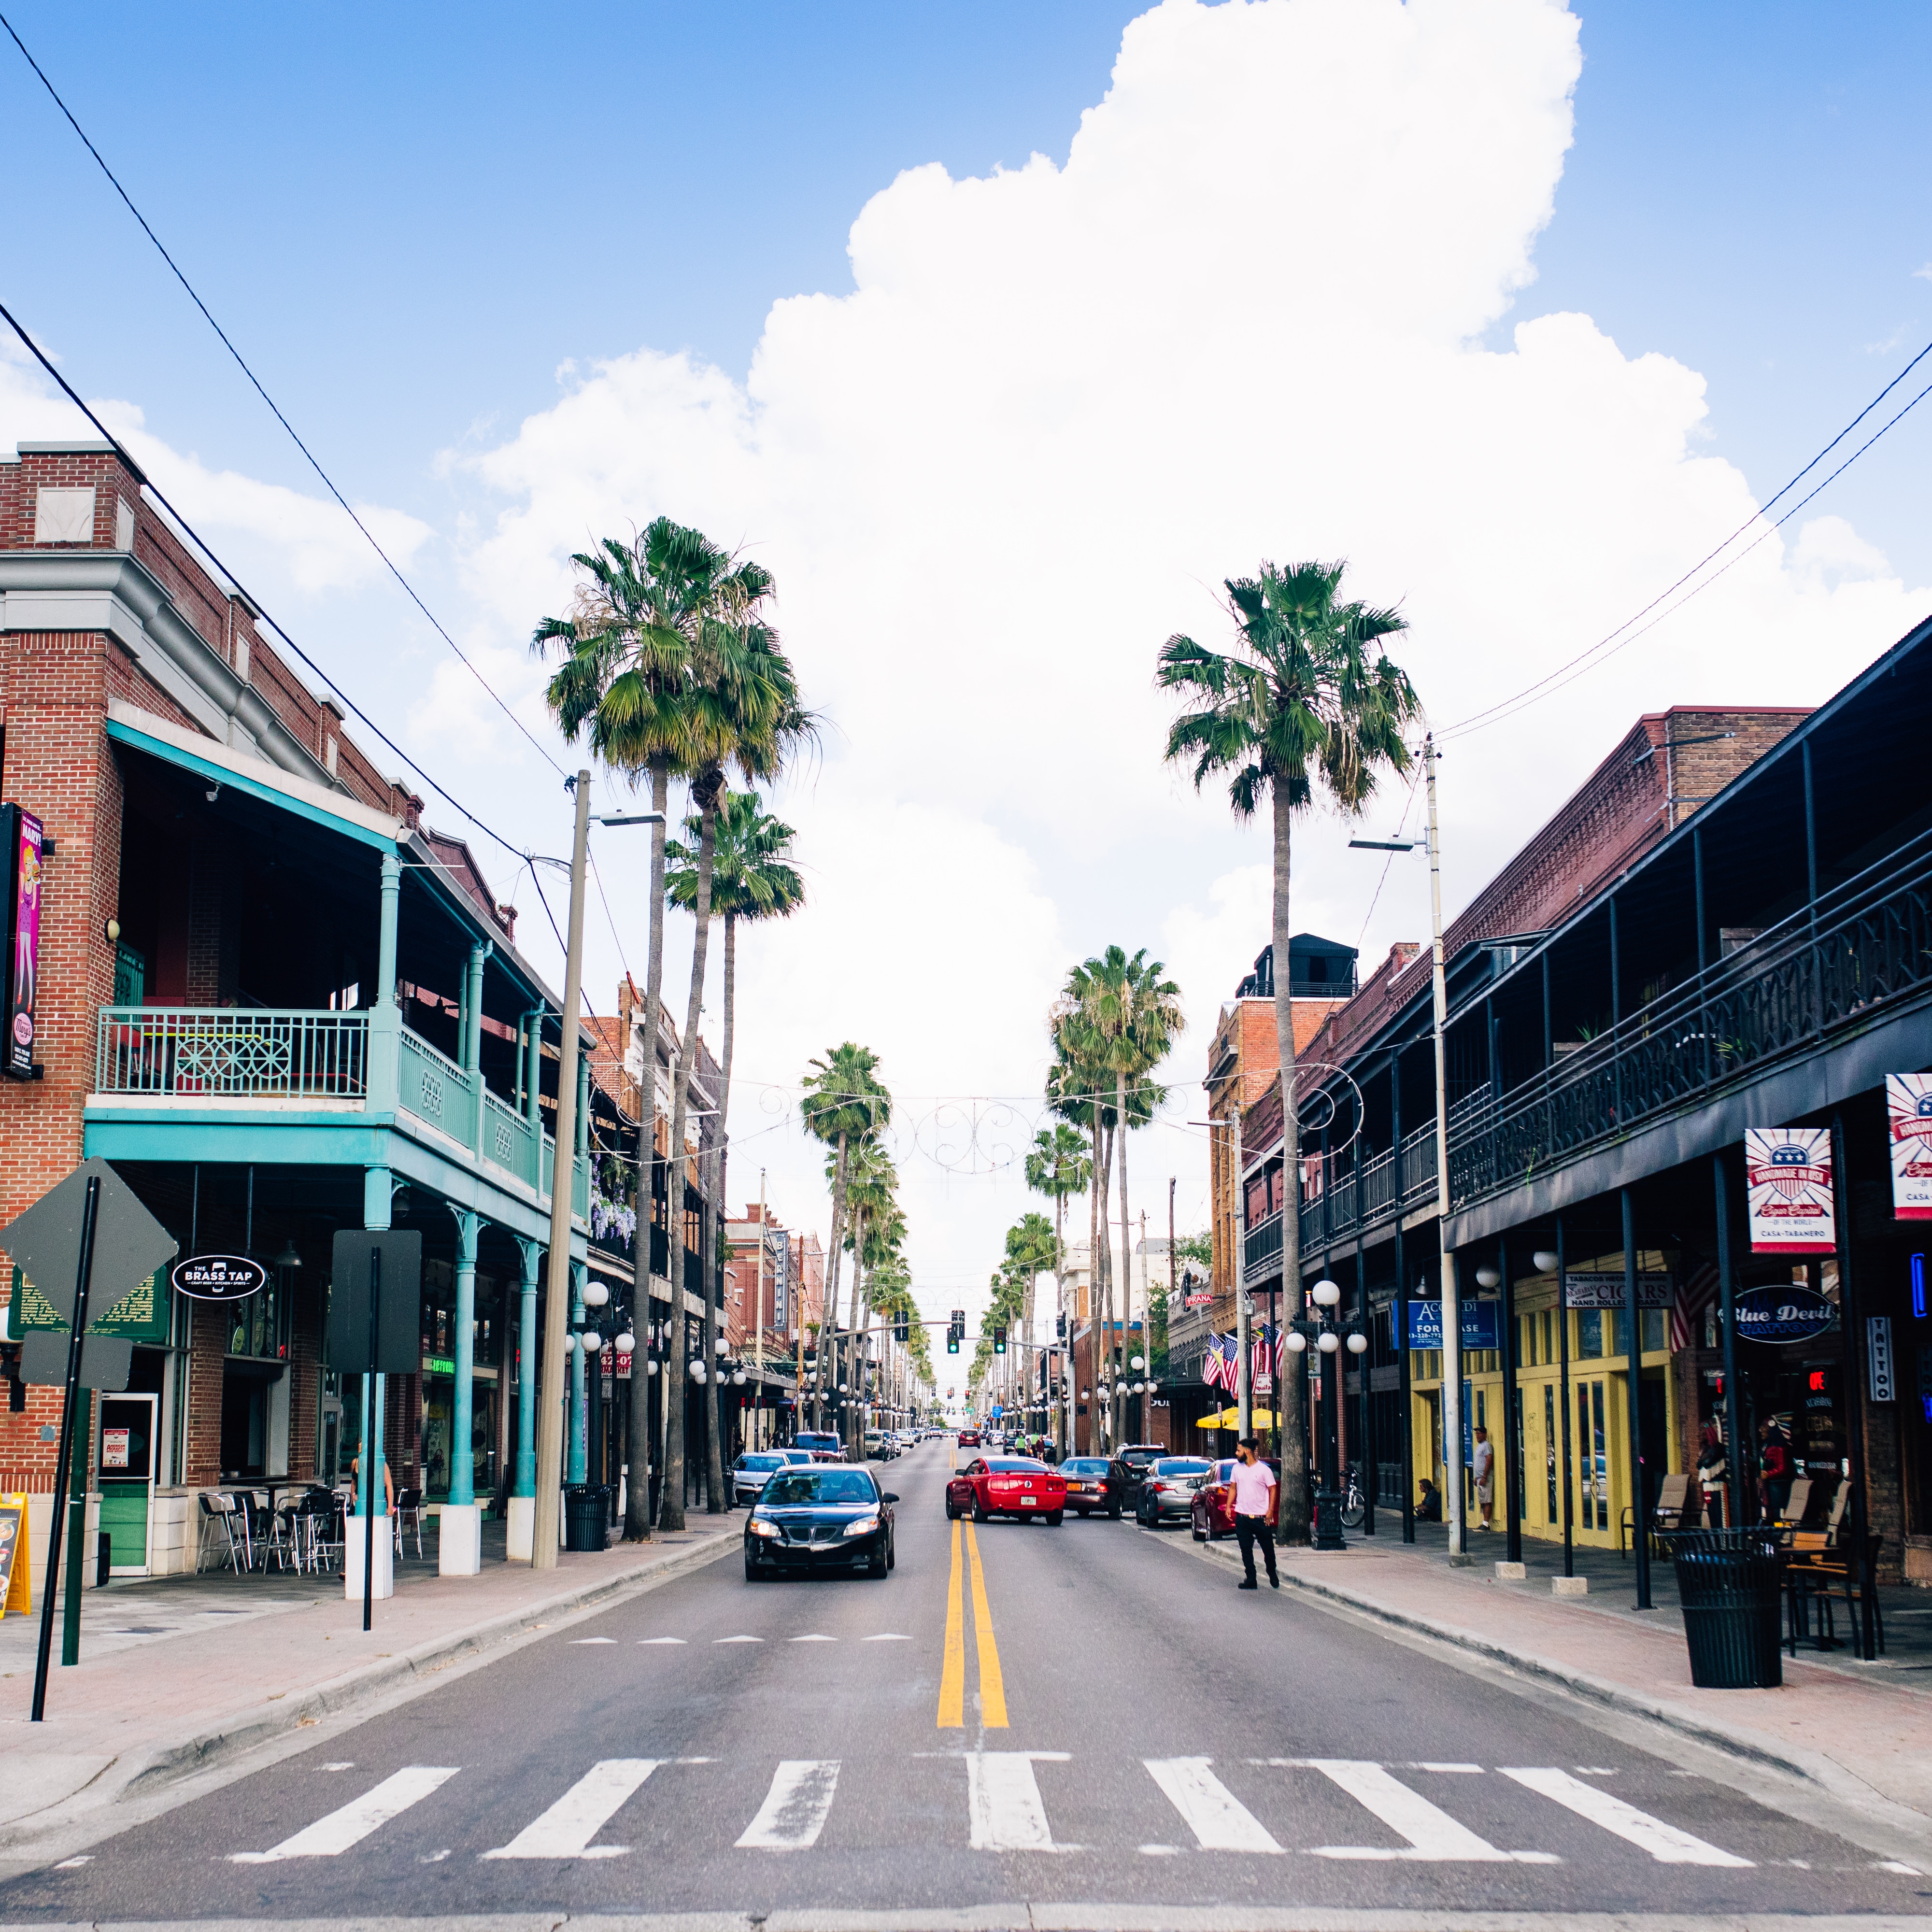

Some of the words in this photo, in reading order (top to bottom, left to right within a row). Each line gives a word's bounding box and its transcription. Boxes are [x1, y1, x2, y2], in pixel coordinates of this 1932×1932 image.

[22, 823, 42, 847] MARY!
[16, 1017, 32, 1038] Mary's
[1899, 1120, 1932, 1136] HANDM
[1754, 1169, 1797, 1182] HANDMADE
[1798, 1169, 1807, 1179] IN
[1808, 1170, 1824, 1183] USA
[1906, 1163, 1932, 1178] Ciga
[1761, 1205, 1787, 1217] Cigar
[1787, 1205, 1822, 1217] Capital
[185, 1271, 226, 1280] BRASS
[228, 1272, 252, 1280] TAP
[1187, 1295, 1212, 1304] PRANA
[1417, 1303, 1477, 1320] ACDI
[1776, 1305, 1832, 1321] Devil
[1739, 1322, 1821, 1335] TATTOO
[1875, 1319, 1889, 1398] TATTOO
